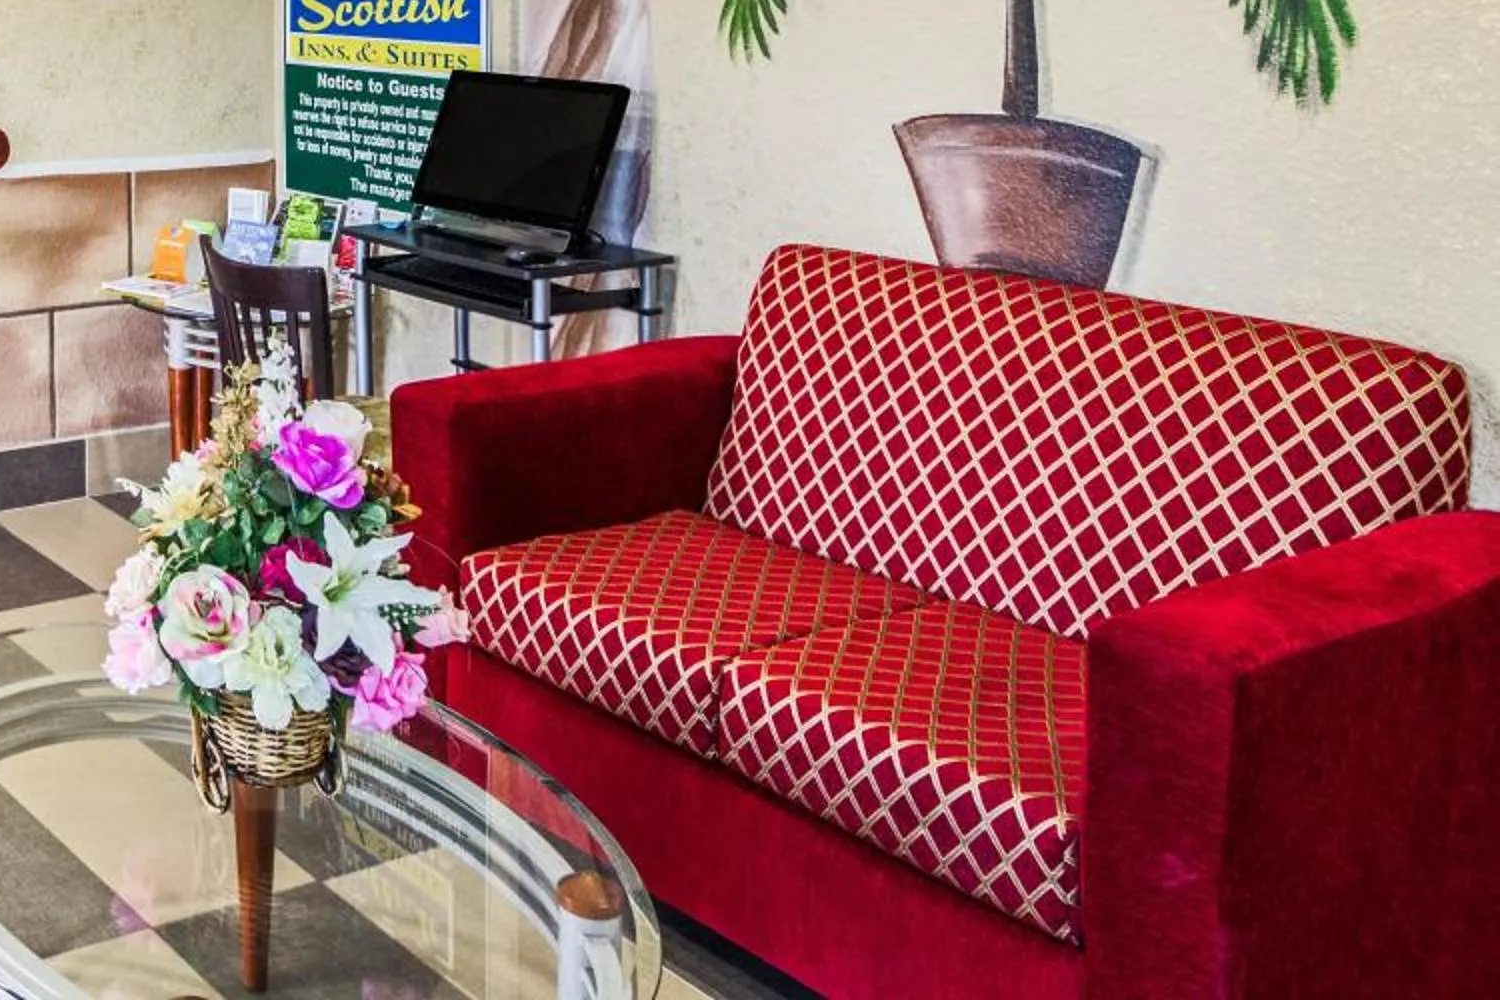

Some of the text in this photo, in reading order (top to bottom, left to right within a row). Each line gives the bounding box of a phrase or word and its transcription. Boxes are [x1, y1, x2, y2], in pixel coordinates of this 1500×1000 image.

[355, 42, 378, 63] &
[386, 44, 469, 70] SUITES
[317, 72, 445, 101] Notice to Guests
[364, 163, 392, 181] Thank
[350, 177, 368, 192] The
